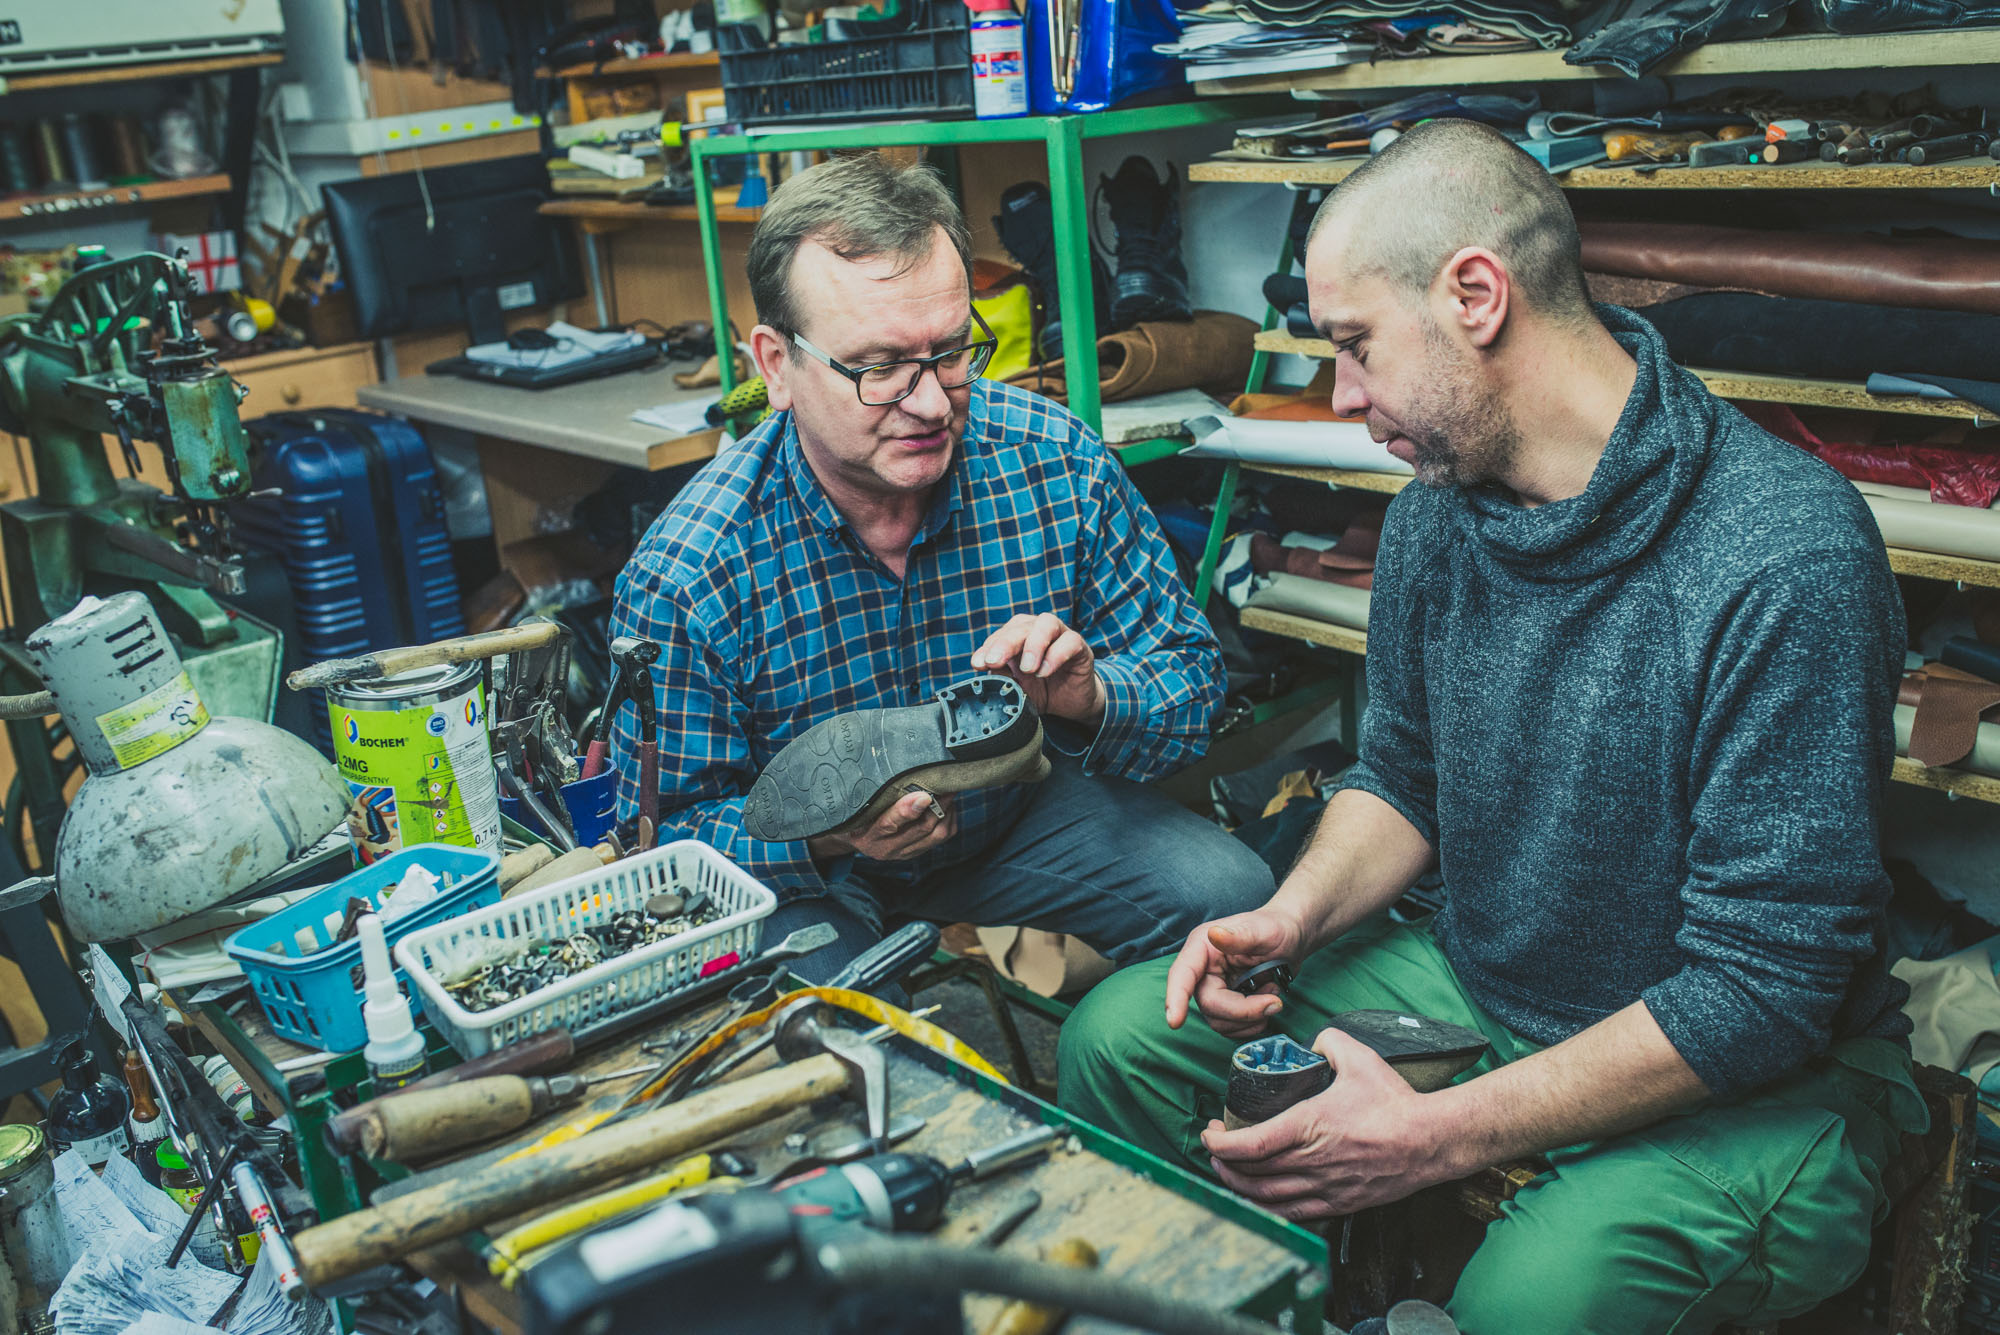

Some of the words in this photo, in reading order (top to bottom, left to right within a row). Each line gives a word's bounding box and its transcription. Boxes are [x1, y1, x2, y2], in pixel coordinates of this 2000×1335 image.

[359, 737, 405, 748] BOCHEM
[343, 755, 369, 773] 2MG
[820, 777, 839, 816] RYŁKO
[475, 830, 488, 844] 0,7
